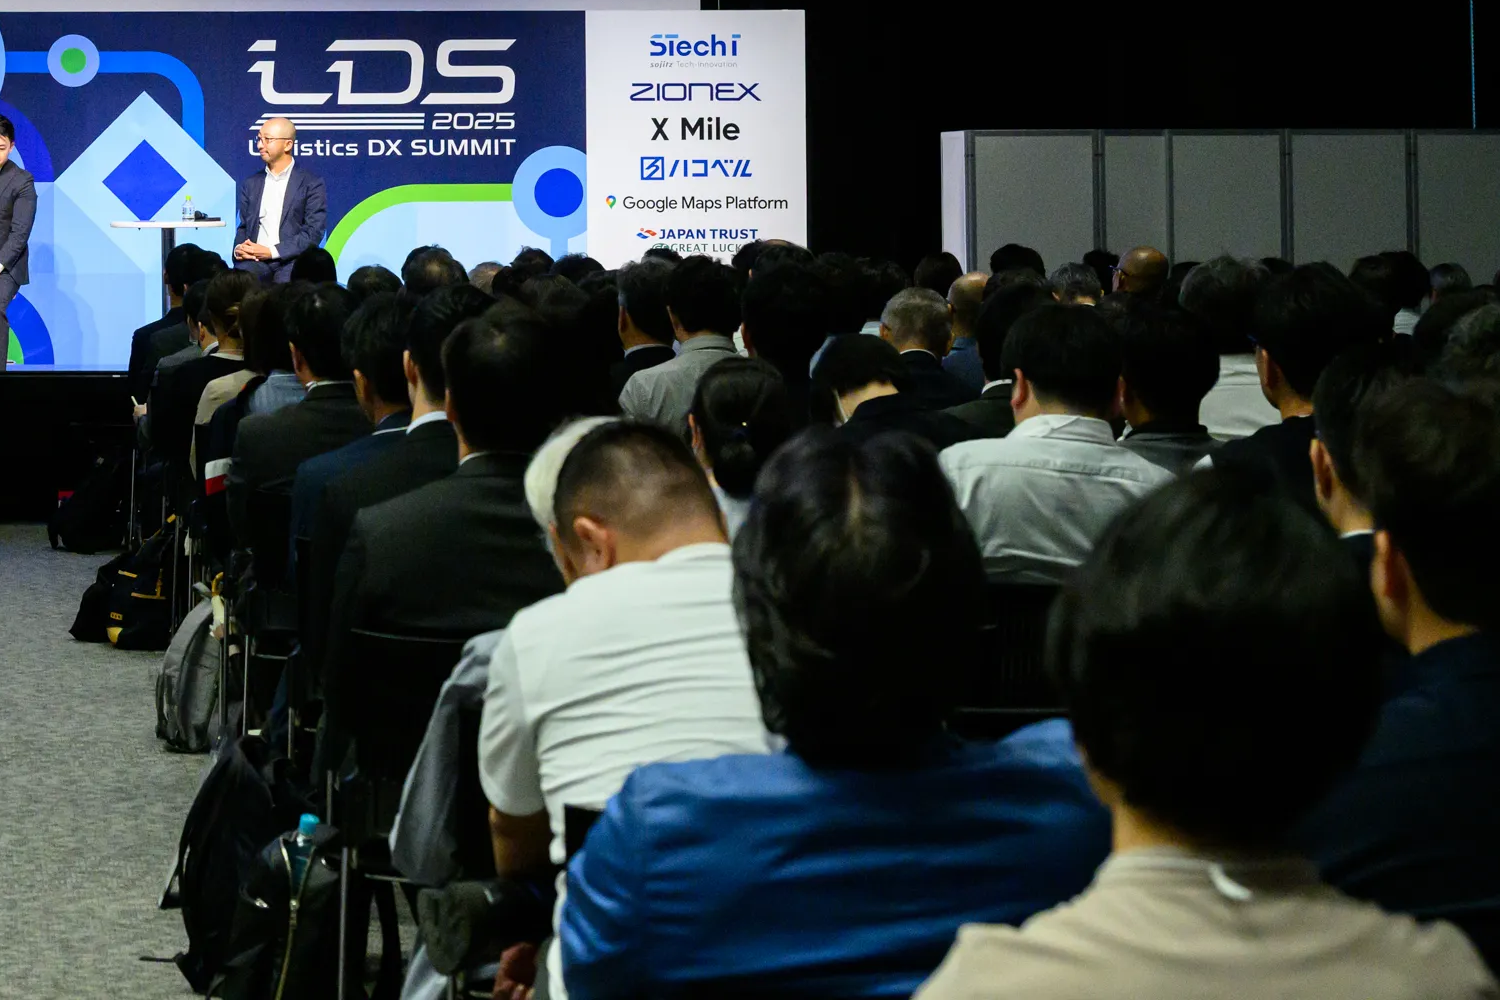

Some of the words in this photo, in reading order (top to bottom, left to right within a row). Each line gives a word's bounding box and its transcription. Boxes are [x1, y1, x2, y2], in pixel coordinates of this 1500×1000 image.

[432, 112, 516, 130] 2025
[651, 117, 669, 141] X
[681, 116, 741, 141] Mile
[248, 139, 359, 156] Listics
[368, 139, 402, 156] DX
[411, 138, 516, 156] SUMMIT
[669, 159, 752, 177] ハコベル
[623, 196, 678, 213] Google
[681, 196, 722, 213] Maps
[726, 196, 788, 210] Platform
[659, 229, 706, 239] JAPAN
[710, 229, 758, 239] TRUST
[671, 243, 708, 252] GREAT
[713, 243, 742, 252] LUCK
